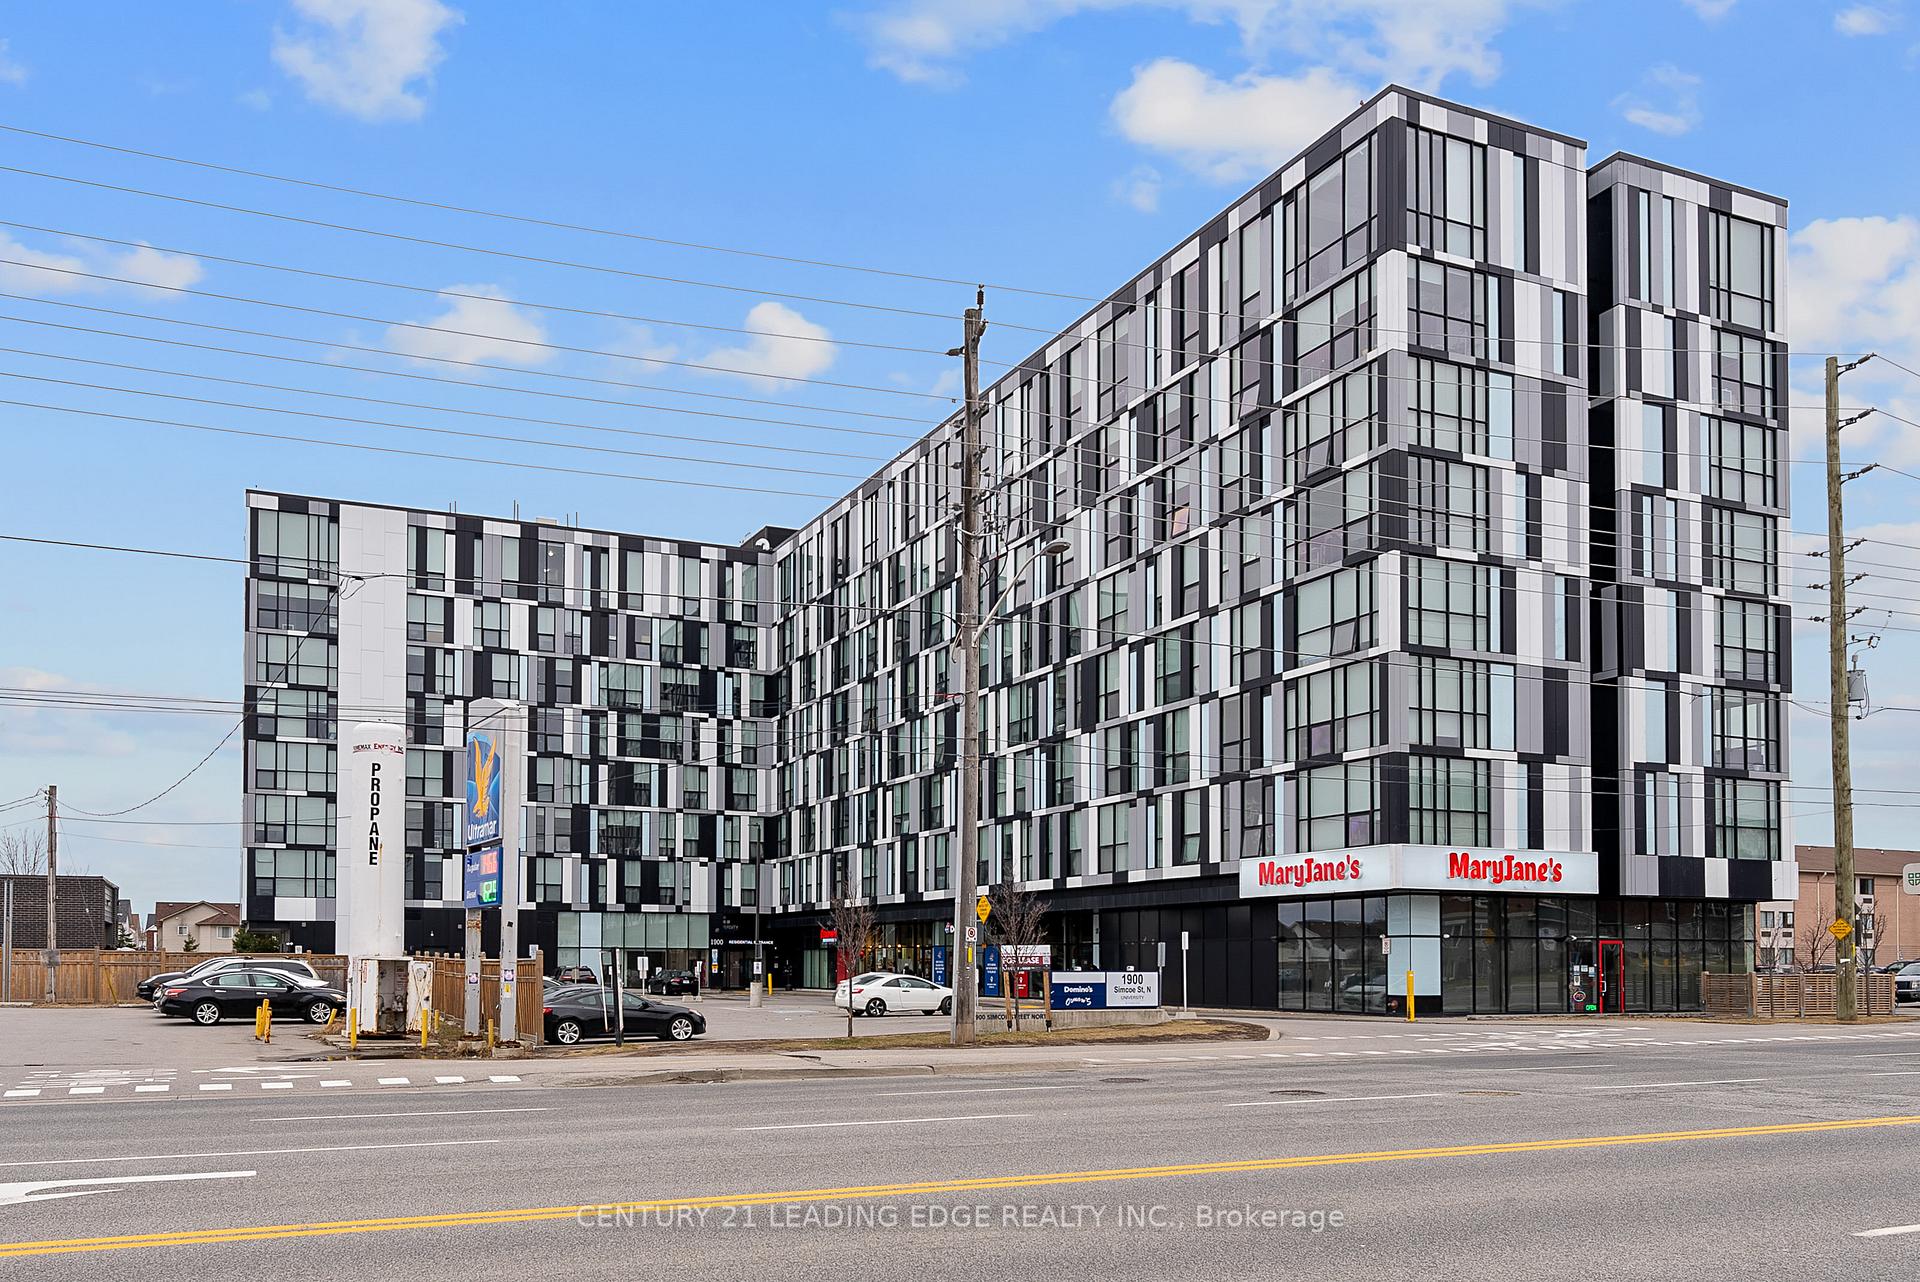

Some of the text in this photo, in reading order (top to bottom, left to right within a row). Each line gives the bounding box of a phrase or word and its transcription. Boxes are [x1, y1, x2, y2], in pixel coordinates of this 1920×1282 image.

[369, 762, 381, 866] PROPANE
[467, 820, 497, 841] Ultramar
[1258, 854, 1361, 887] MaryJane's
[1449, 852, 1563, 884] MaryJane's
[1018, 956, 1040, 964] LEASE
[1121, 974, 1144, 985] 1900
[1063, 985, 1093, 994] Domino's
[1113, 986, 1136, 994] Simcoe
